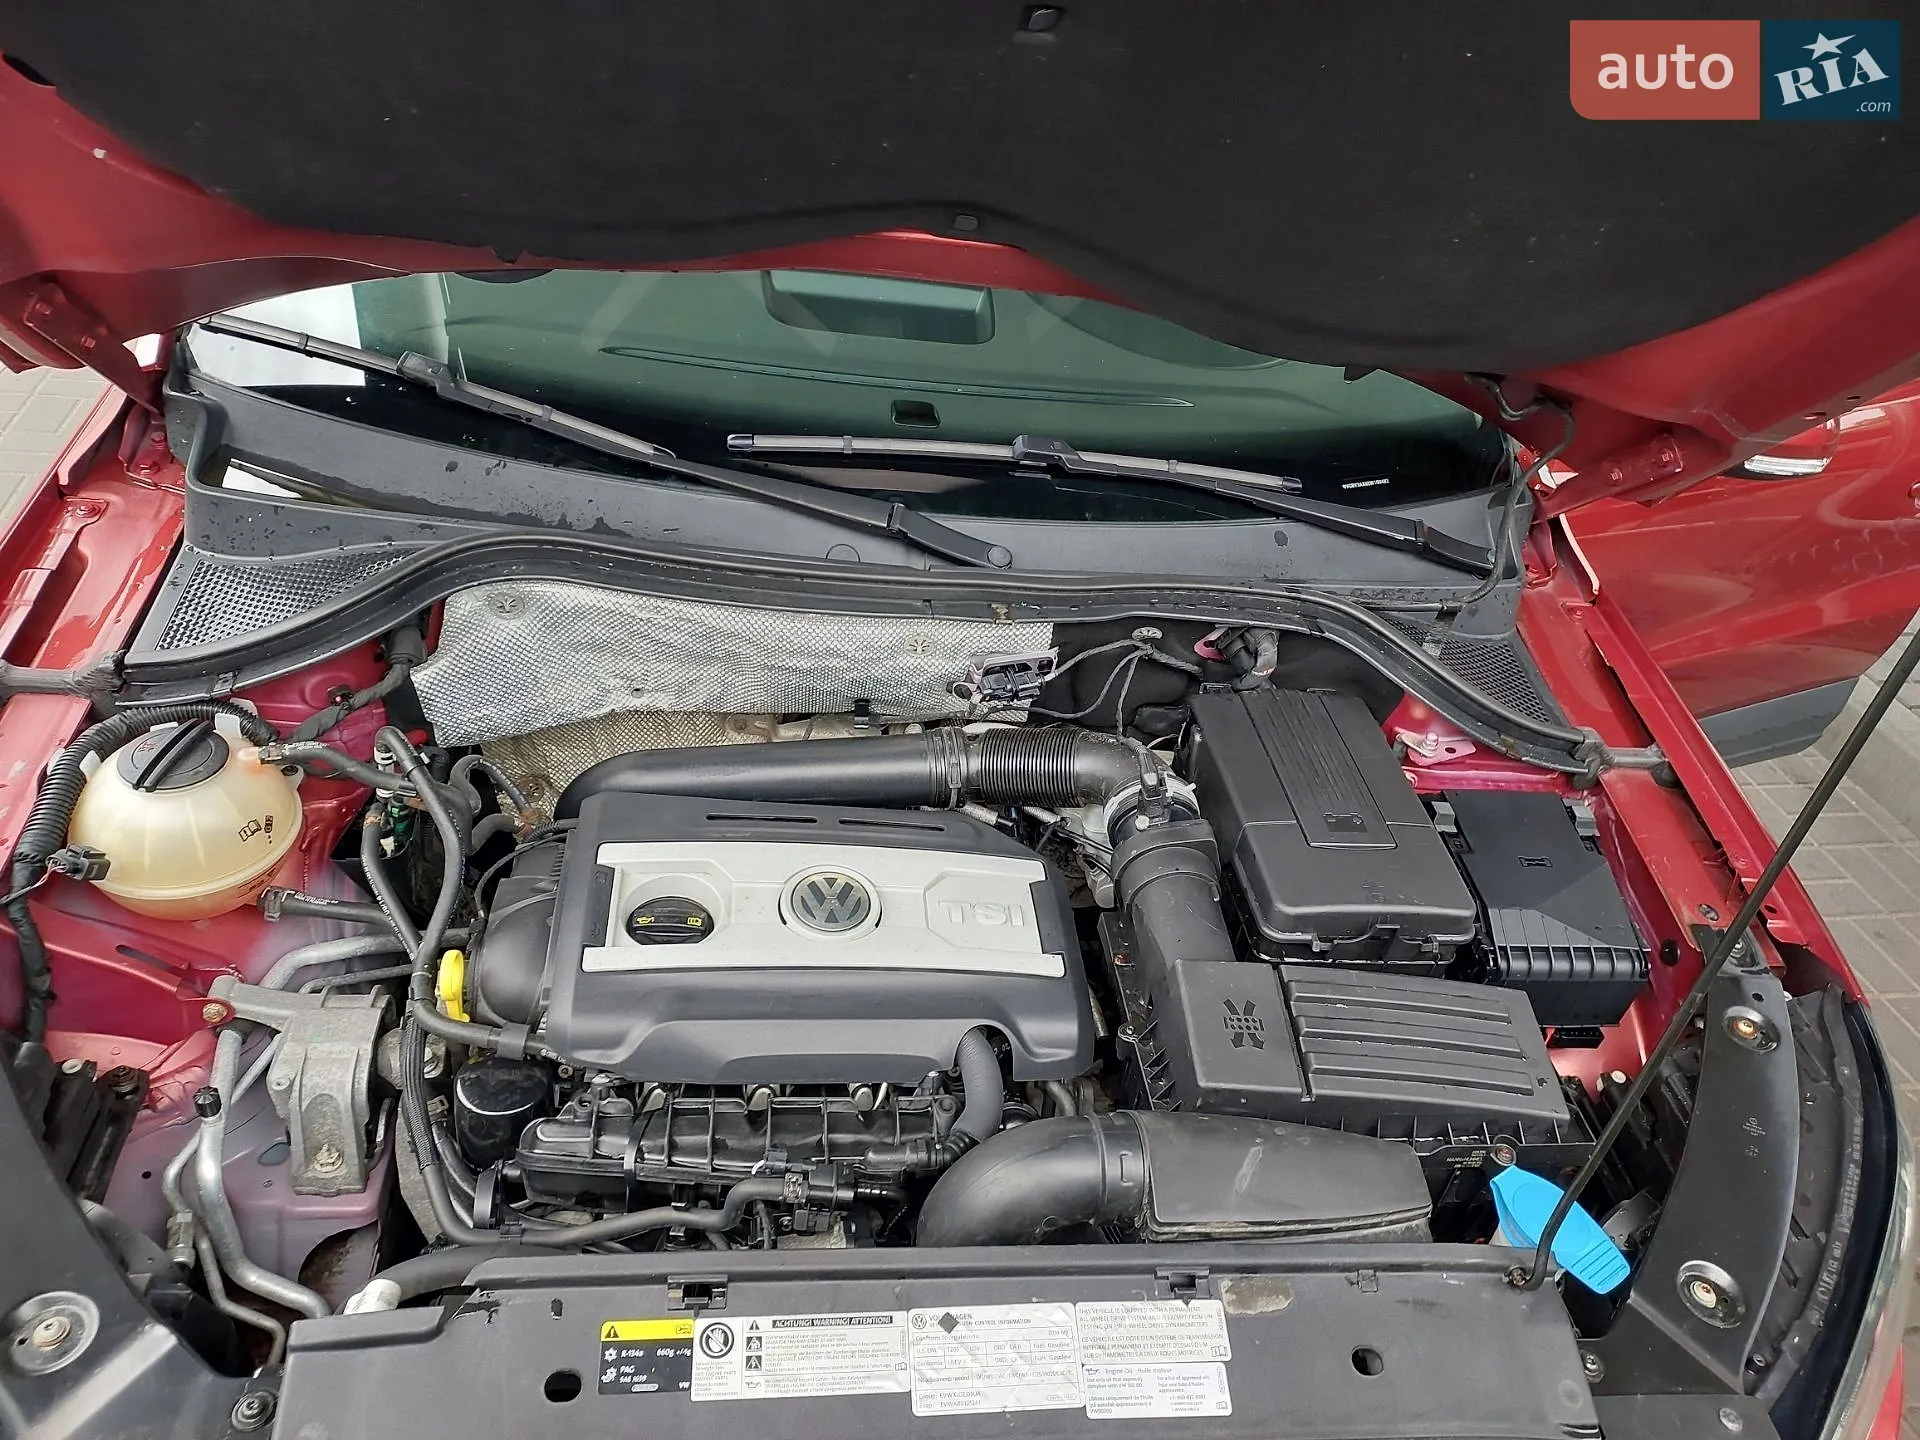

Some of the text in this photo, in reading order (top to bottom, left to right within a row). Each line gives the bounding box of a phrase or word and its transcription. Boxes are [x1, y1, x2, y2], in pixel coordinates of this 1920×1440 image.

[938, 900, 1025, 926] TSI
[774, 1315, 891, 1328] ACHTUNG! WARNING! ATTENTION!
[1105, 1368, 1123, 1376] Engine
